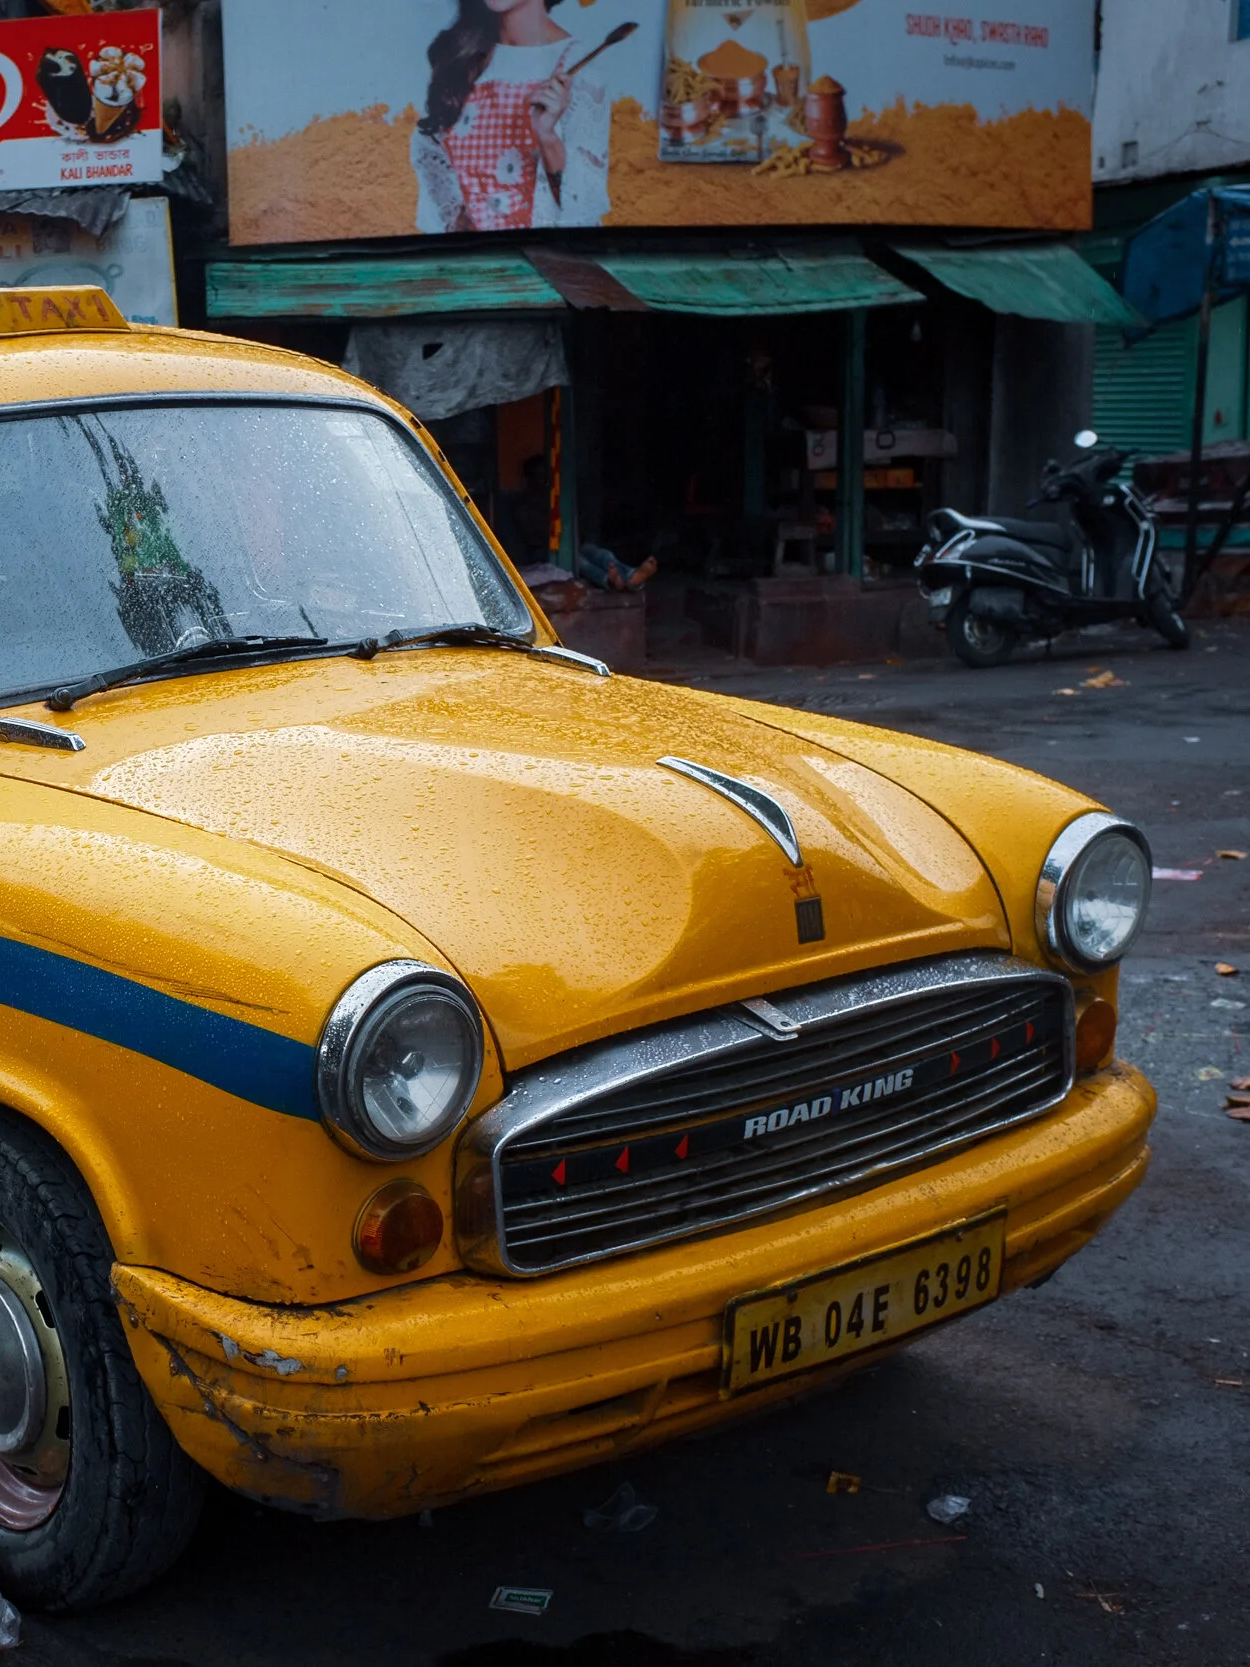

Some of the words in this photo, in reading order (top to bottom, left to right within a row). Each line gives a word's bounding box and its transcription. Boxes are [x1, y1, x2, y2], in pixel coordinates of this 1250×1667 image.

[60, 167, 83, 180] KALI
[86, 163, 133, 179] BHANDAR
[11, 293, 110, 322] TAXI
[744, 1096, 832, 1139] ROAD
[838, 1068, 915, 1110] KING
[749, 1315, 803, 1374] WB
[824, 1284, 891, 1348] 04E
[913, 1246, 992, 1316] 6398
